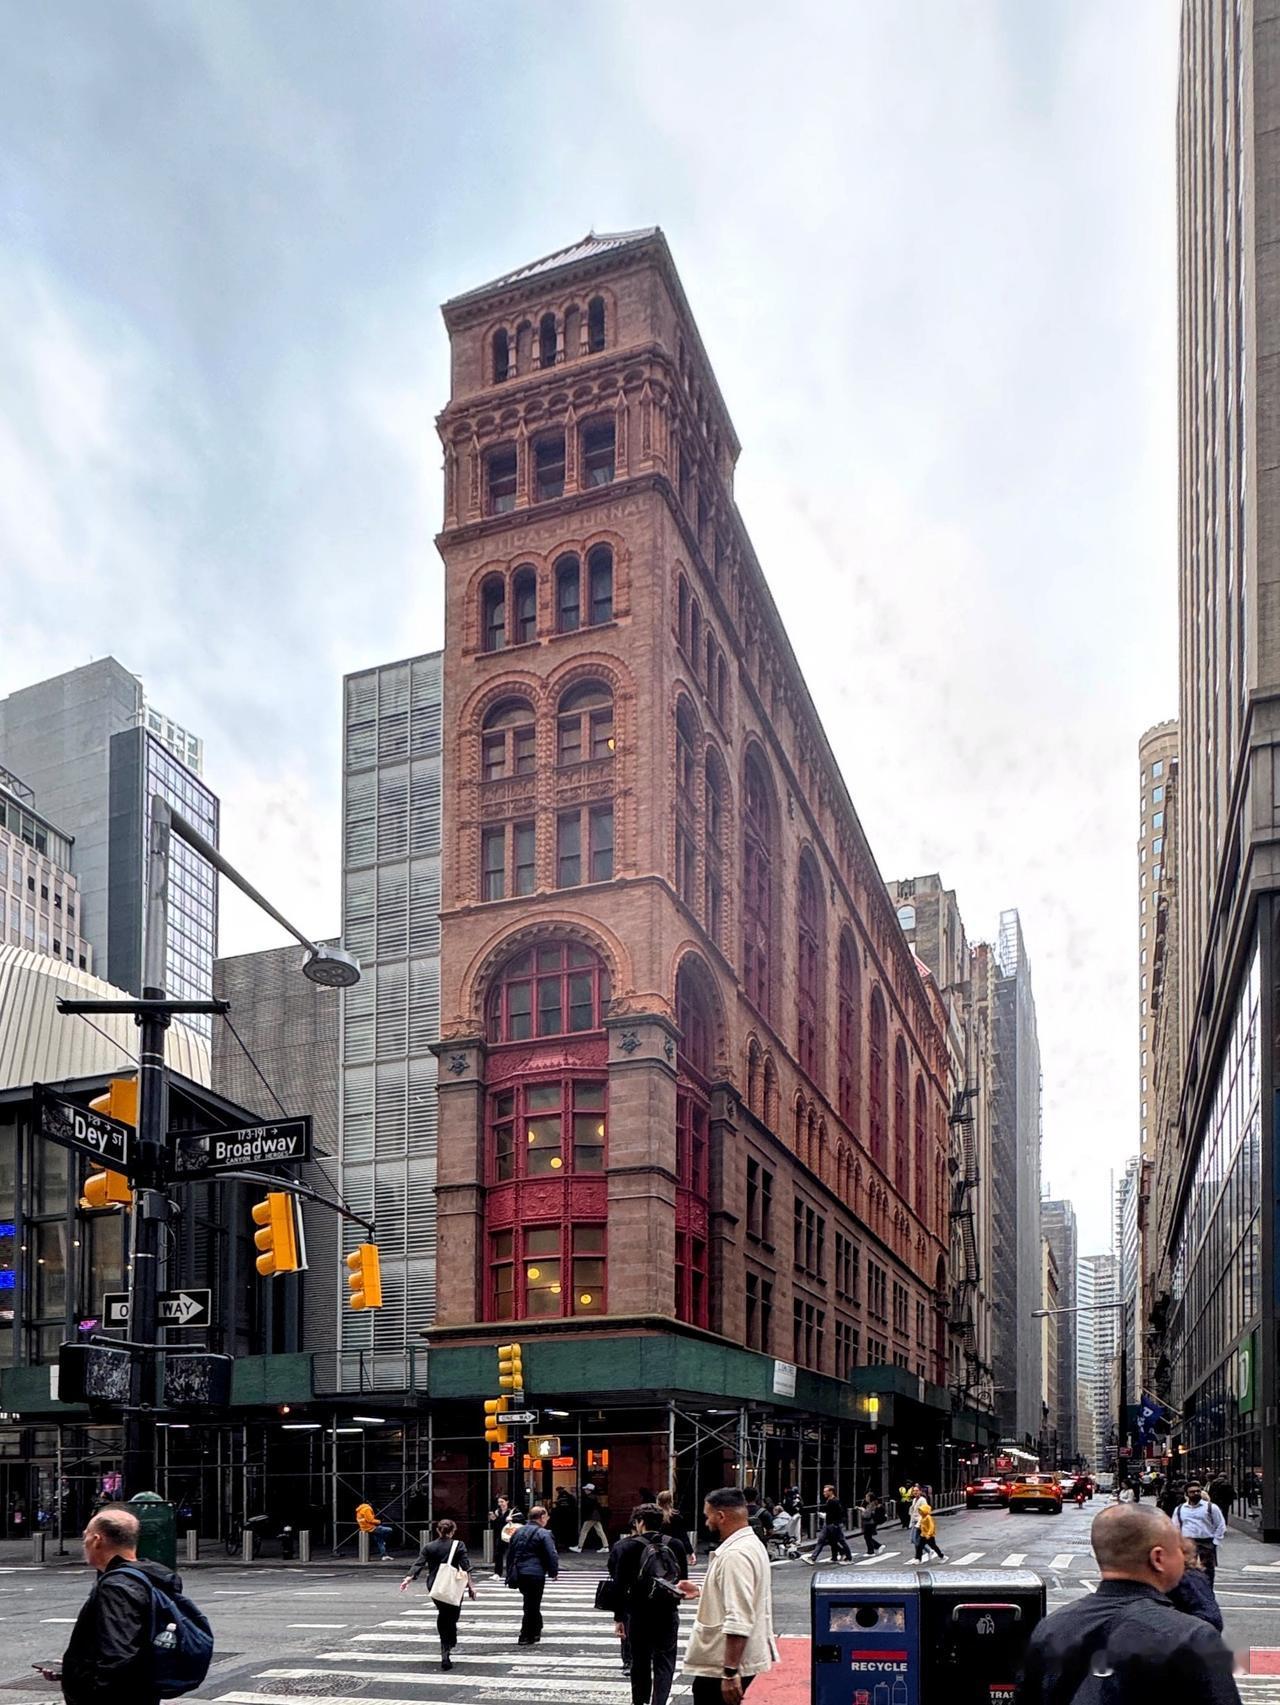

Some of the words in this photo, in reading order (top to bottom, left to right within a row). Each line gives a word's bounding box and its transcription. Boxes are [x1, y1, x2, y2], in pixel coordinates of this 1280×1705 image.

[557, 502, 649, 532] JOURNAL
[76, 1115, 108, 1153] Dey
[112, 1133, 122, 1146] ST
[216, 1136, 297, 1159] Broadway
[225, 1156, 251, 1164] CANYON
[163, 1303, 193, 1316] WAY
[851, 1662, 908, 1672] RECYCLE
[989, 1691, 1015, 1699] TRAS
